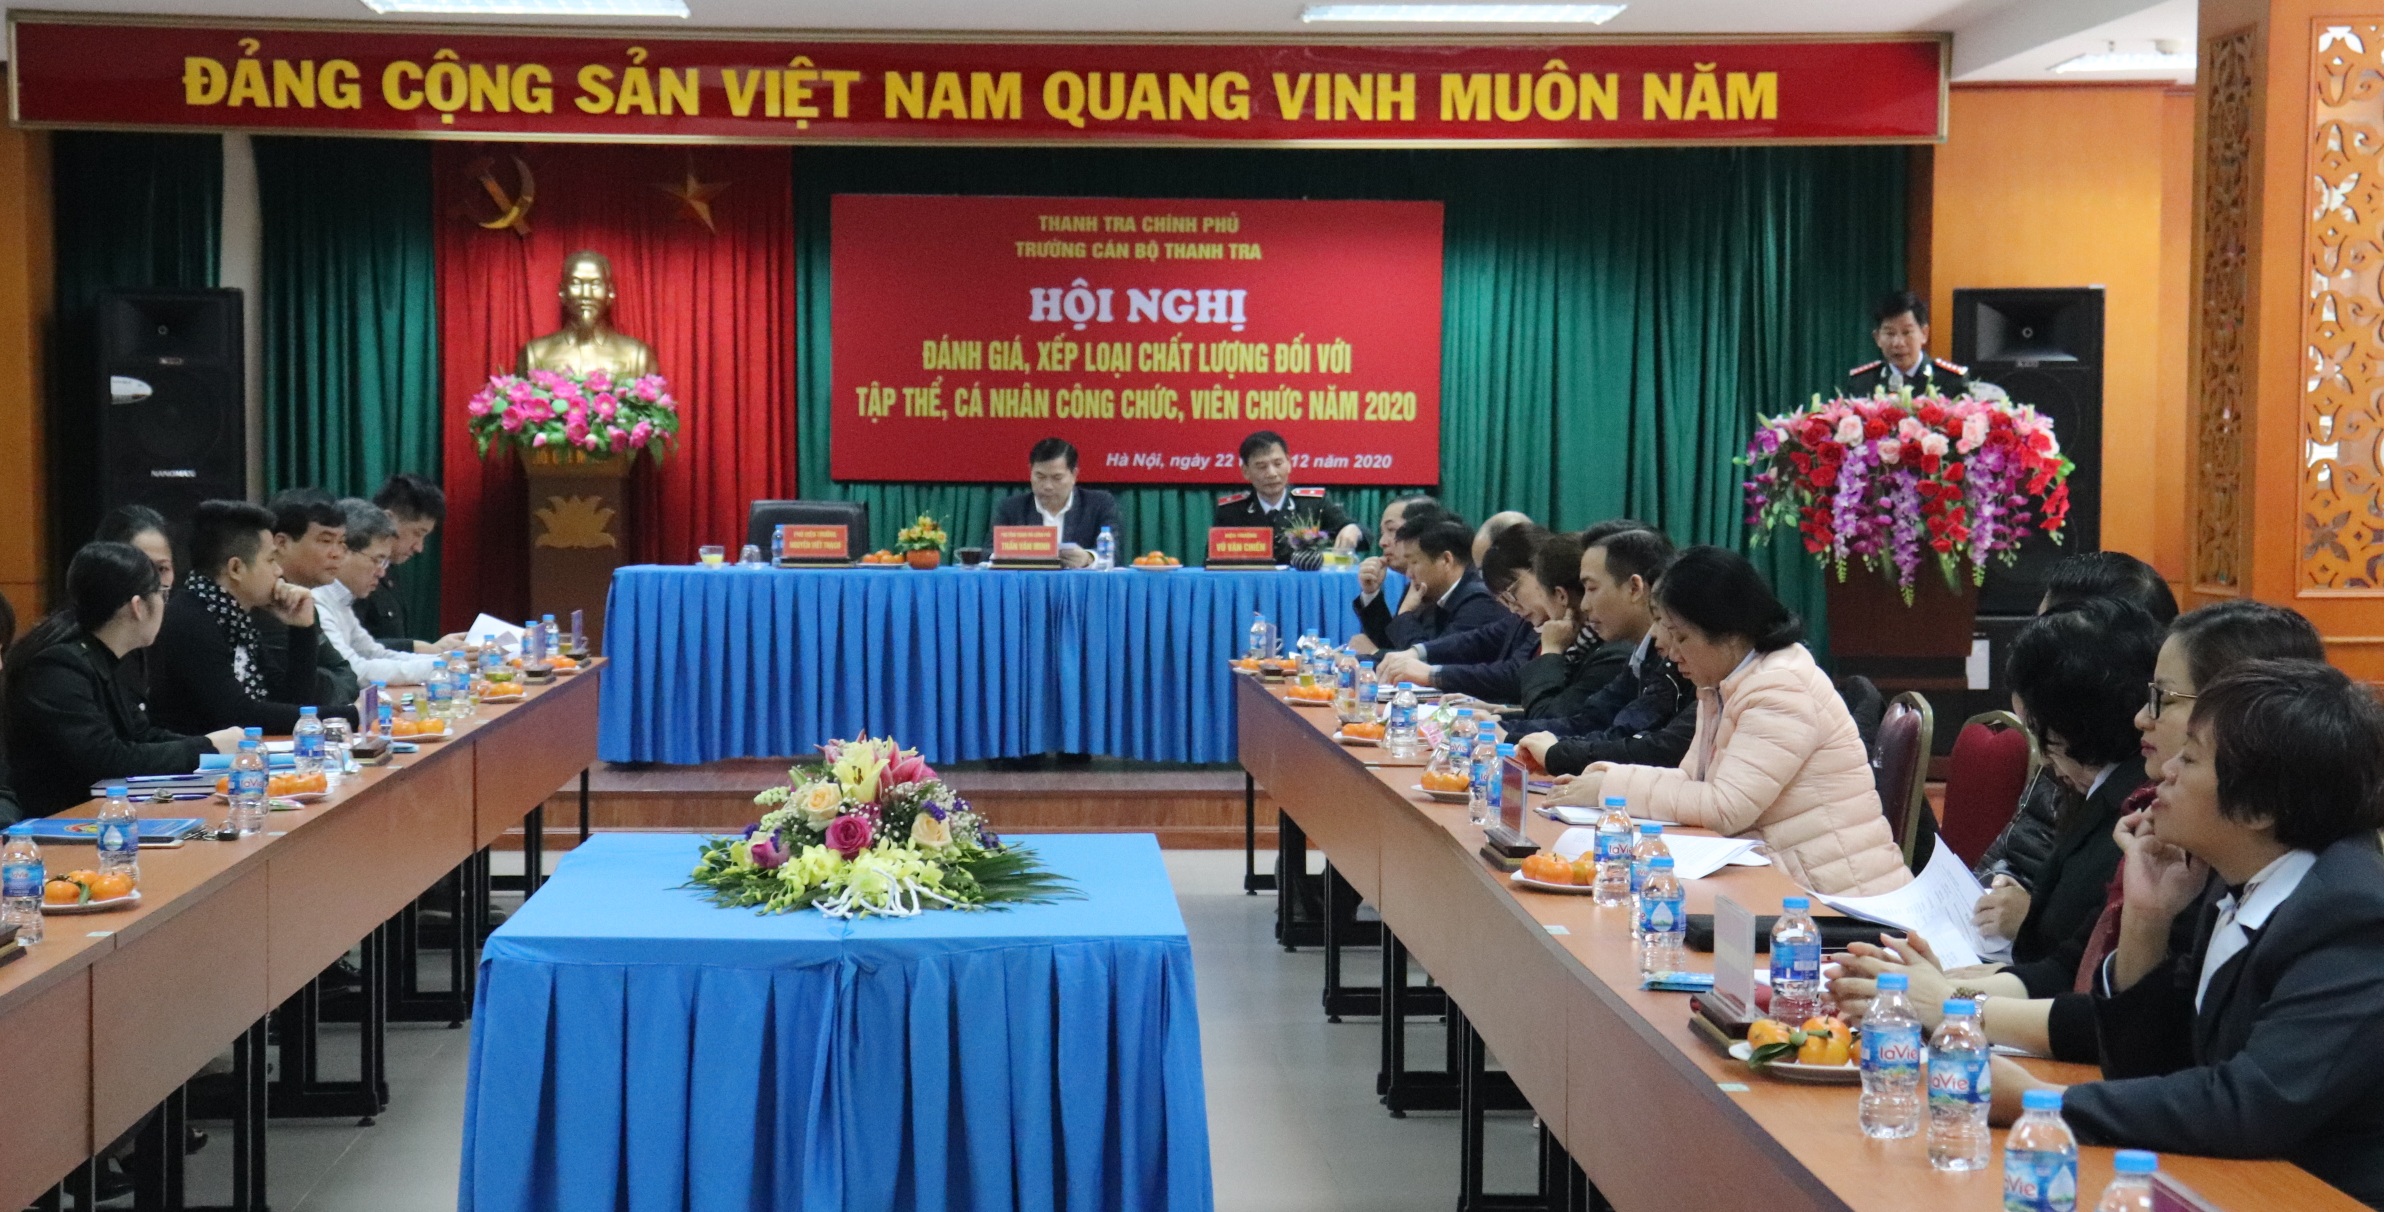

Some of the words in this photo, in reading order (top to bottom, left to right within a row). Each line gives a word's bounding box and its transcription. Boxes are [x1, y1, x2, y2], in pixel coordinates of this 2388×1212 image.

[183, 39, 362, 108] ĐẢNG
[382, 49, 553, 124] CỘNG
[575, 47, 700, 117] SẢN
[722, 56, 861, 129] VIỆT
[885, 71, 1022, 120] NAM
[1042, 71, 1250, 128] QUANG
[1273, 72, 1416, 121] VINH
[1440, 59, 1618, 121] MUÔN
[1643, 63, 1778, 121] NĂM
[1039, 215, 1098, 231] THANH
[1103, 216, 1136, 232] TRA
[1142, 214, 1197, 232] CHÍNH
[1203, 212, 1239, 233] PHỦ
[1015, 239, 1087, 258] TRƯỜNG
[1092, 240, 1129, 258] CÁN
[1135, 240, 1160, 262] BỘ
[1165, 243, 1224, 259] THANH
[1229, 243, 1262, 260] TRA
[1029, 277, 1114, 331] HỘI
[1127, 288, 1247, 332] NGHỊ
[922, 334, 982, 370] ĐÁNH
[988, 335, 1030, 375] GIÁ,
[1036, 332, 1078, 371] XẾP
[1085, 342, 1132, 379] LOẠI
[1138, 332, 1193, 372] CHẤT
[1199, 340, 1269, 379] LƯỢNG
[1274, 333, 1311, 373] ĐỐI
[1317, 337, 1351, 373] VỚI
[856, 380, 896, 423] TẬP
[903, 375, 948, 421] THỂ,
[954, 381, 983, 417] CÁ
[989, 382, 1049, 418] NHÂN
[1056, 383, 1114, 419] CÔNG
[1121, 383, 1185, 423] CHỨC,
[1191, 383, 1239, 419] VIÊN
[1245, 383, 1303, 420] CHỨC
[1308, 384, 1358, 420] NĂM
[1365, 391, 1416, 421] 2020
[1106, 453, 1128, 467] Hà
[1133, 453, 1165, 470] Nội,
[1170, 454, 1210, 470] ngày
[1215, 454, 1235, 467] 22
[1291, 454, 1309, 468] 12
[1313, 454, 1349, 468] năm
[1354, 455, 1393, 469] 2020
[1450, 743, 1466, 752] aVie
[1880, 1044, 1918, 1061] laVie
[1931, 1073, 1968, 1090] aVie
[2005, 1175, 2036, 1197] Vie
